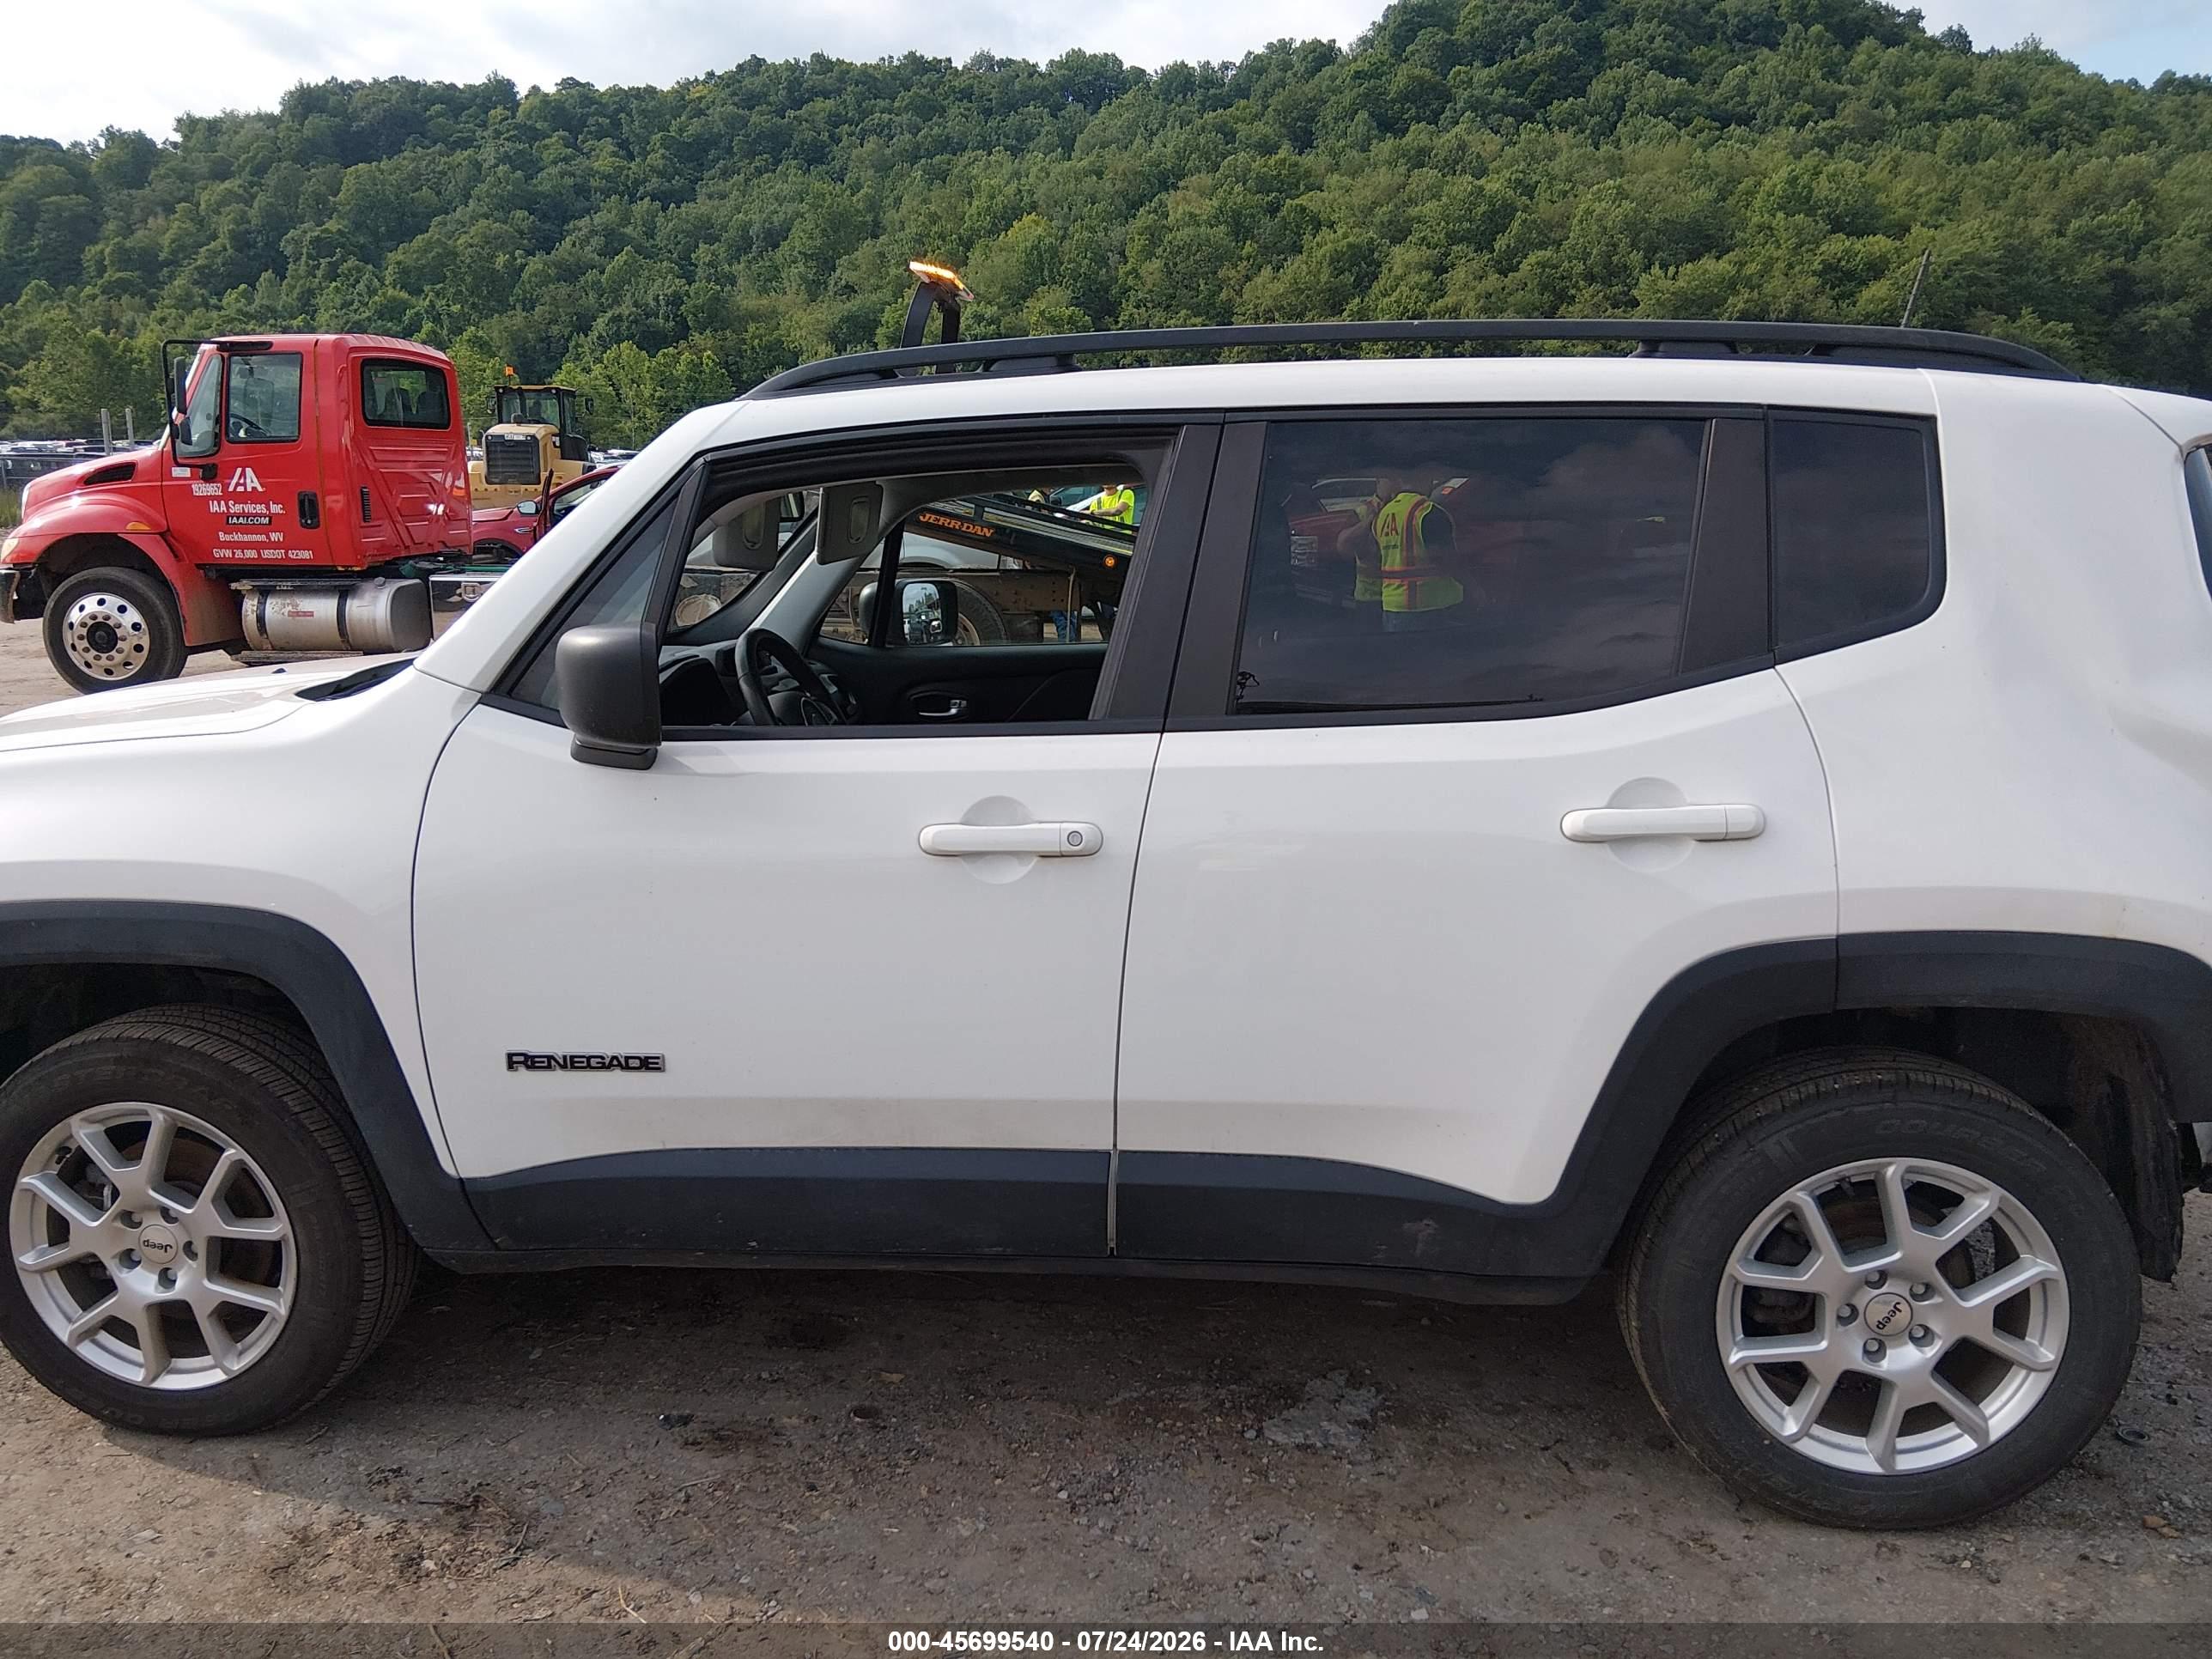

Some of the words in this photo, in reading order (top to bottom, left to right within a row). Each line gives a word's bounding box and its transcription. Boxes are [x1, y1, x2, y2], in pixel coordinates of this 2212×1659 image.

[209, 500, 228, 514] IAA
[228, 500, 269, 515] Services,
[270, 501, 286, 514] Inc.
[228, 516, 270, 525] IAAI.COM
[218, 532, 269, 543] Buckhannon,
[269, 532, 283, 542] WV
[212, 549, 233, 558] GVW
[234, 550, 258, 559] 26,000
[260, 550, 286, 559] USDOT
[506, 1051, 665, 1072] RENEGADE
[142, 1238, 174, 1255] Jeep
[1875, 1301, 1903, 1330] Jeep
